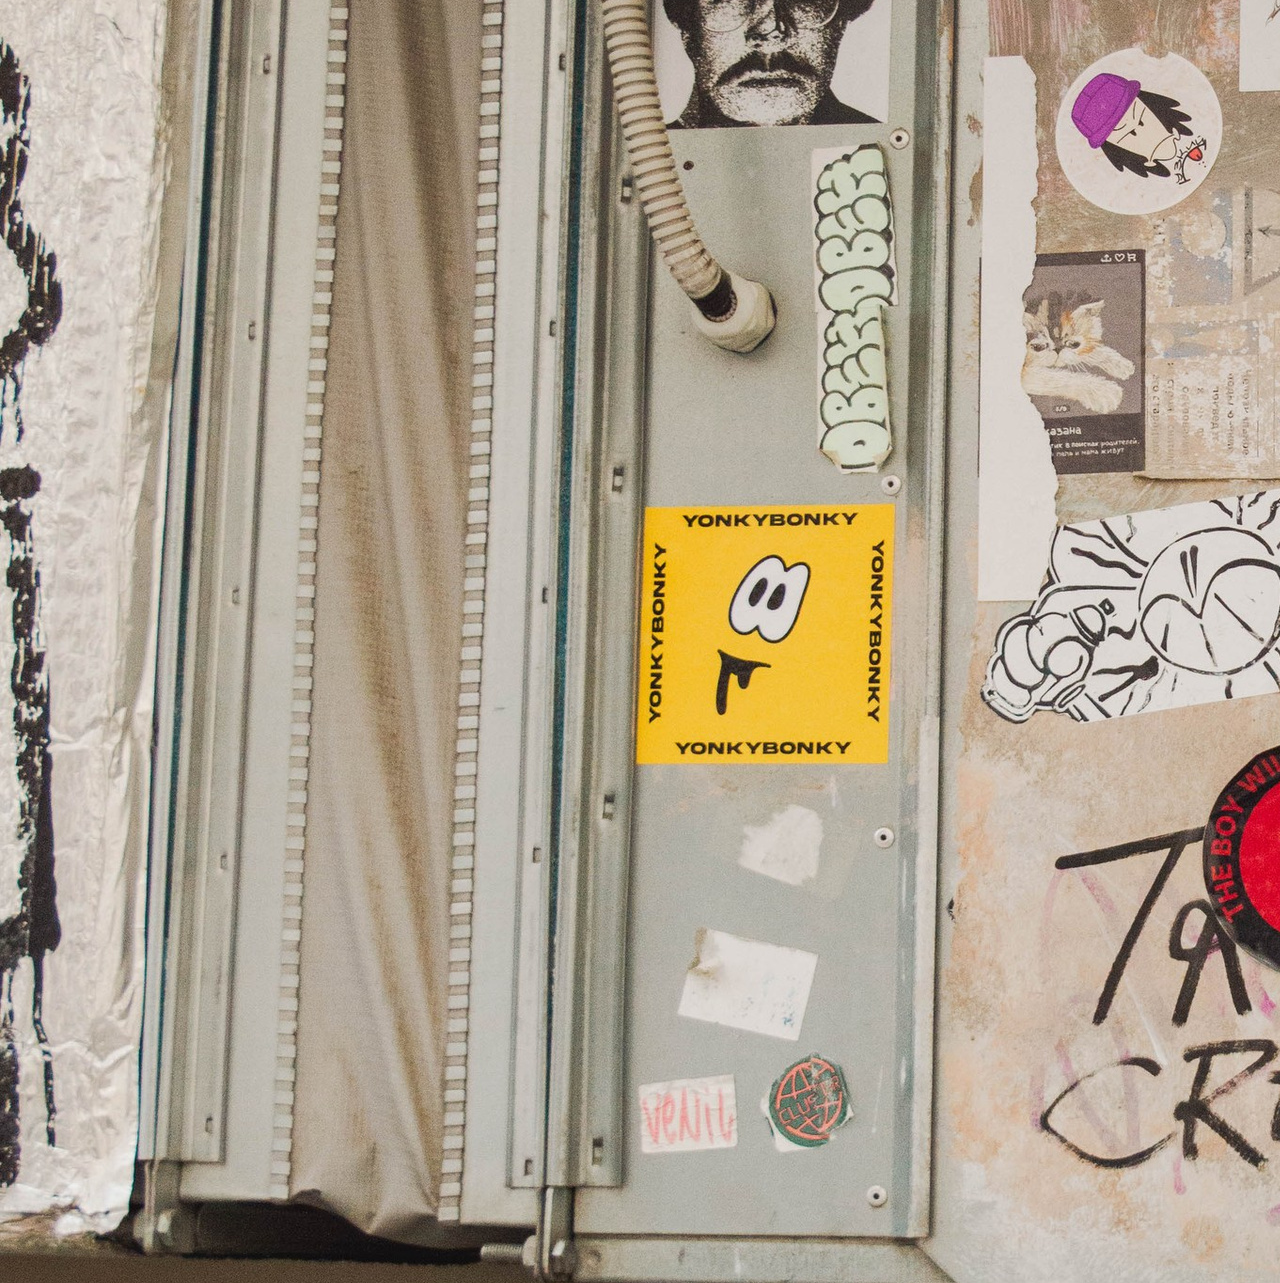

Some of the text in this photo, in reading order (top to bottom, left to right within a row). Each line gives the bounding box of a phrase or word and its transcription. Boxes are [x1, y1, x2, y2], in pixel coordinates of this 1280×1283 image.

[683, 512, 859, 528] YONKYBONKY
[649, 543, 667, 724] YONKYBONKY
[867, 540, 885, 723] YONKYBONKY
[675, 741, 851, 755] YONKYBONKY
[1211, 794, 1244, 857] BOY
[1211, 865, 1244, 923] THE
